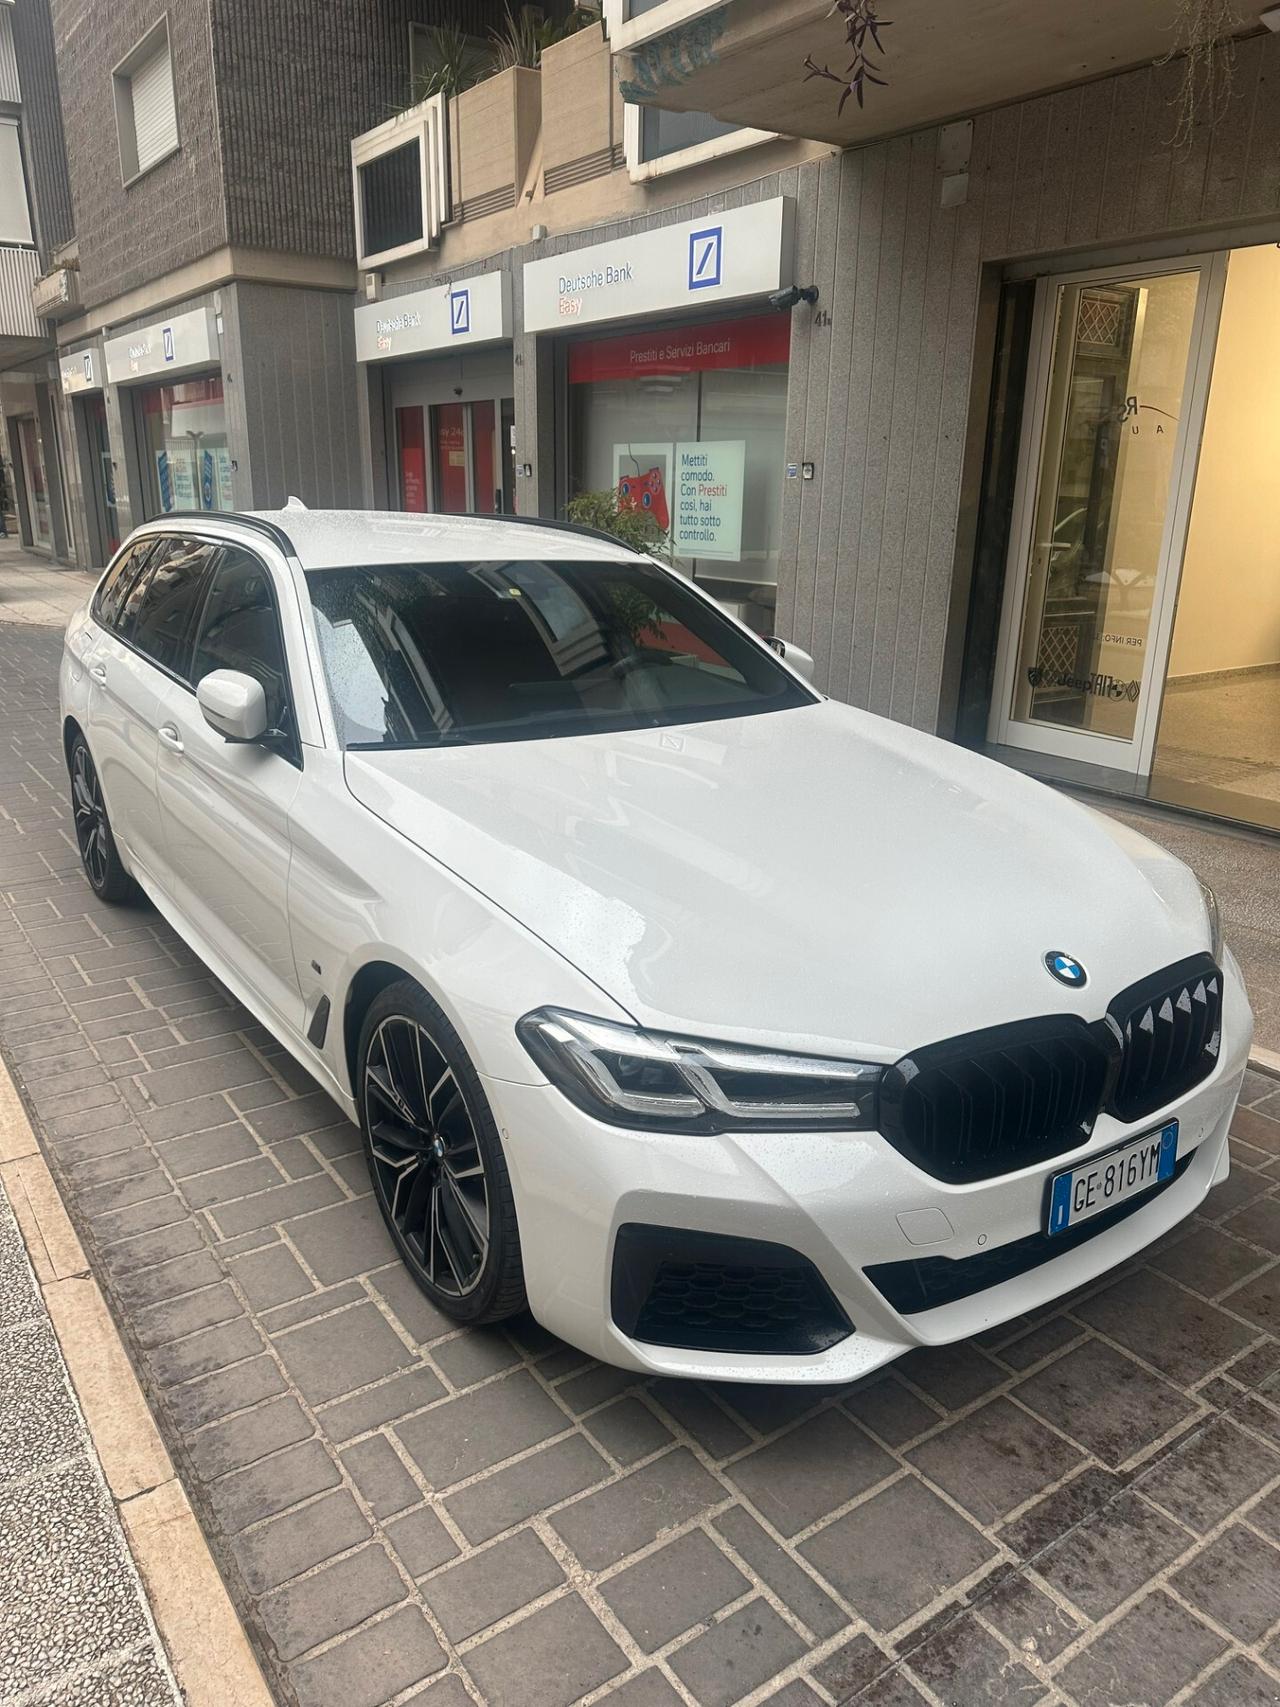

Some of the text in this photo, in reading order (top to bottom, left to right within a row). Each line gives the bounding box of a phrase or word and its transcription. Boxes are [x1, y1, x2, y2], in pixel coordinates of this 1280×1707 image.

[559, 262, 633, 294] Deutsche Bank
[559, 297, 583, 317] Easy
[630, 338, 730, 362] Prestiti e Servizi Bancari
[681, 453, 708, 467] Mettiti
[681, 469, 716, 482] comodo.
[680, 483, 728, 497] Con Prestiti
[680, 498, 712, 512] così, hai
[679, 514, 721, 527] tutto sotto
[679, 529, 717, 542] controllo.
